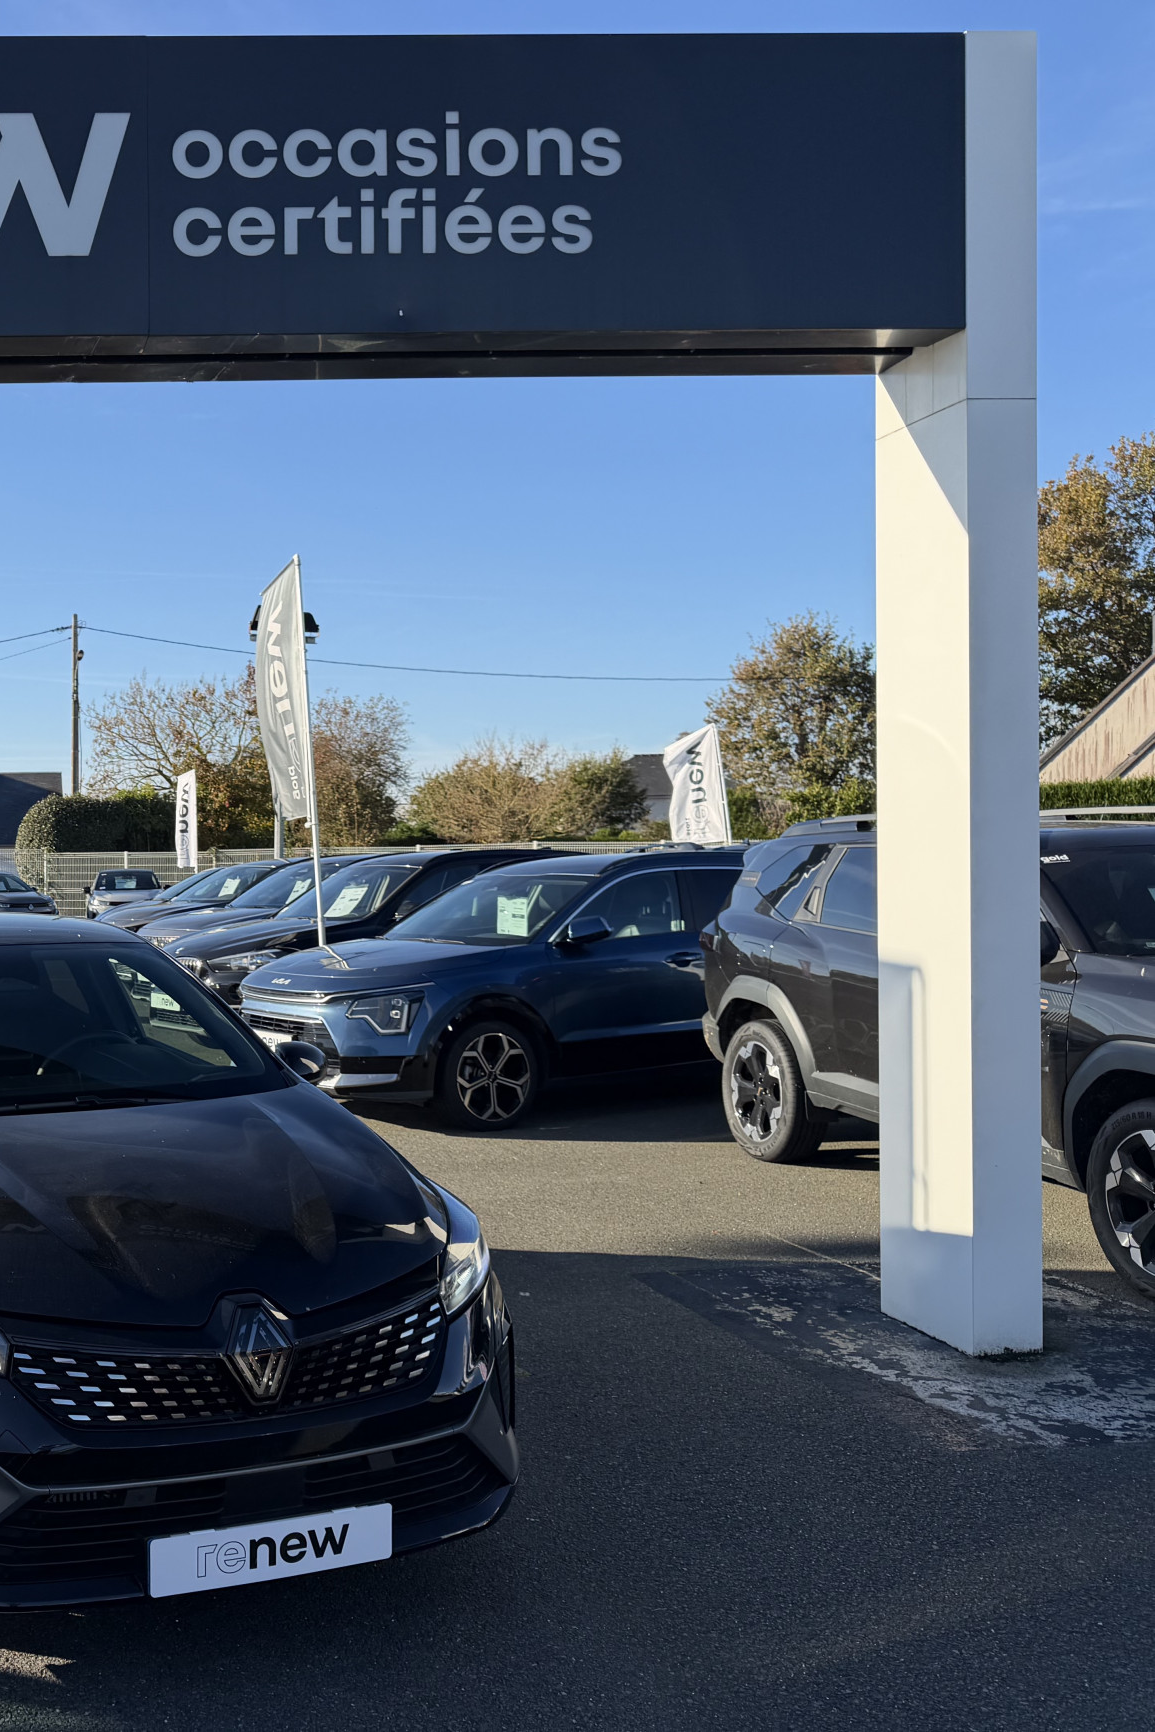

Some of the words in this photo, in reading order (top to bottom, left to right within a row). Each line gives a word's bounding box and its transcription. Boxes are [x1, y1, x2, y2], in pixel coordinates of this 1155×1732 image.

[172, 110, 623, 179] occasions
[172, 188, 594, 258] certifiées
[1040, 854, 1070, 863] gold
[196, 1523, 350, 1578] renew
